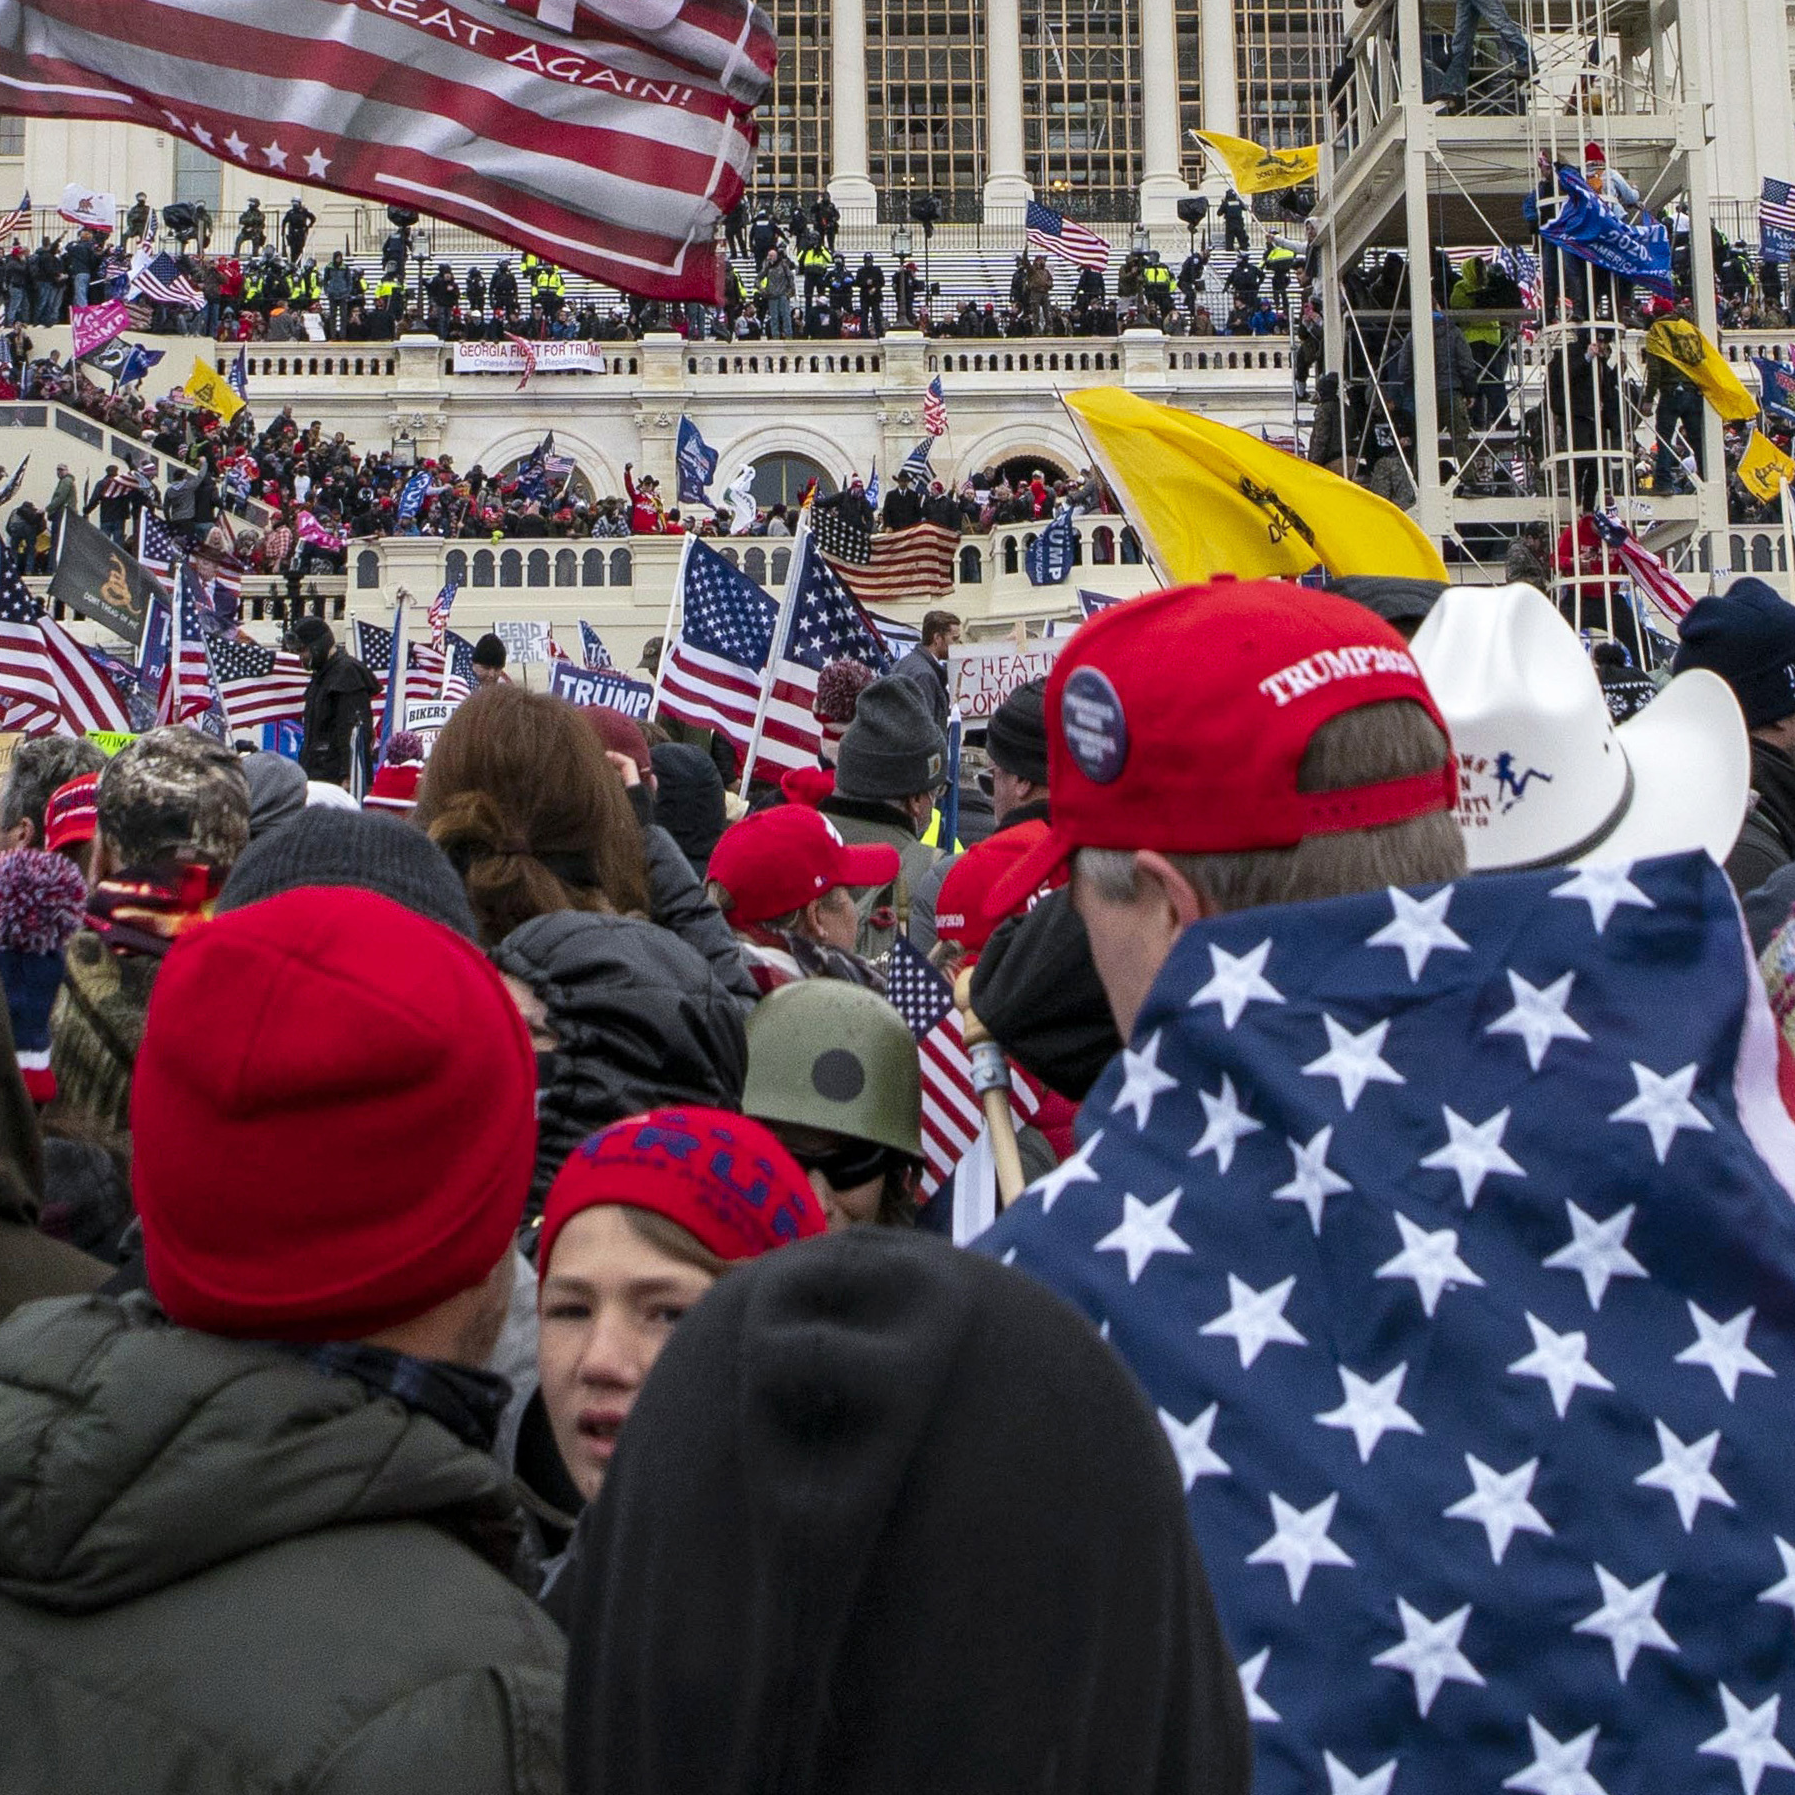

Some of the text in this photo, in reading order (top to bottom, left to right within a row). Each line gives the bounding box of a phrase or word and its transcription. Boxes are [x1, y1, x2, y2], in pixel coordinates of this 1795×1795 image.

[505, 42, 692, 108] AGAIN!
[460, 344, 507, 358] GEORGIA
[544, 345, 566, 357] FOR
[498, 622, 542, 640] SEND
[560, 671, 651, 718] TRUMP
[408, 706, 447, 723] BIKERS
